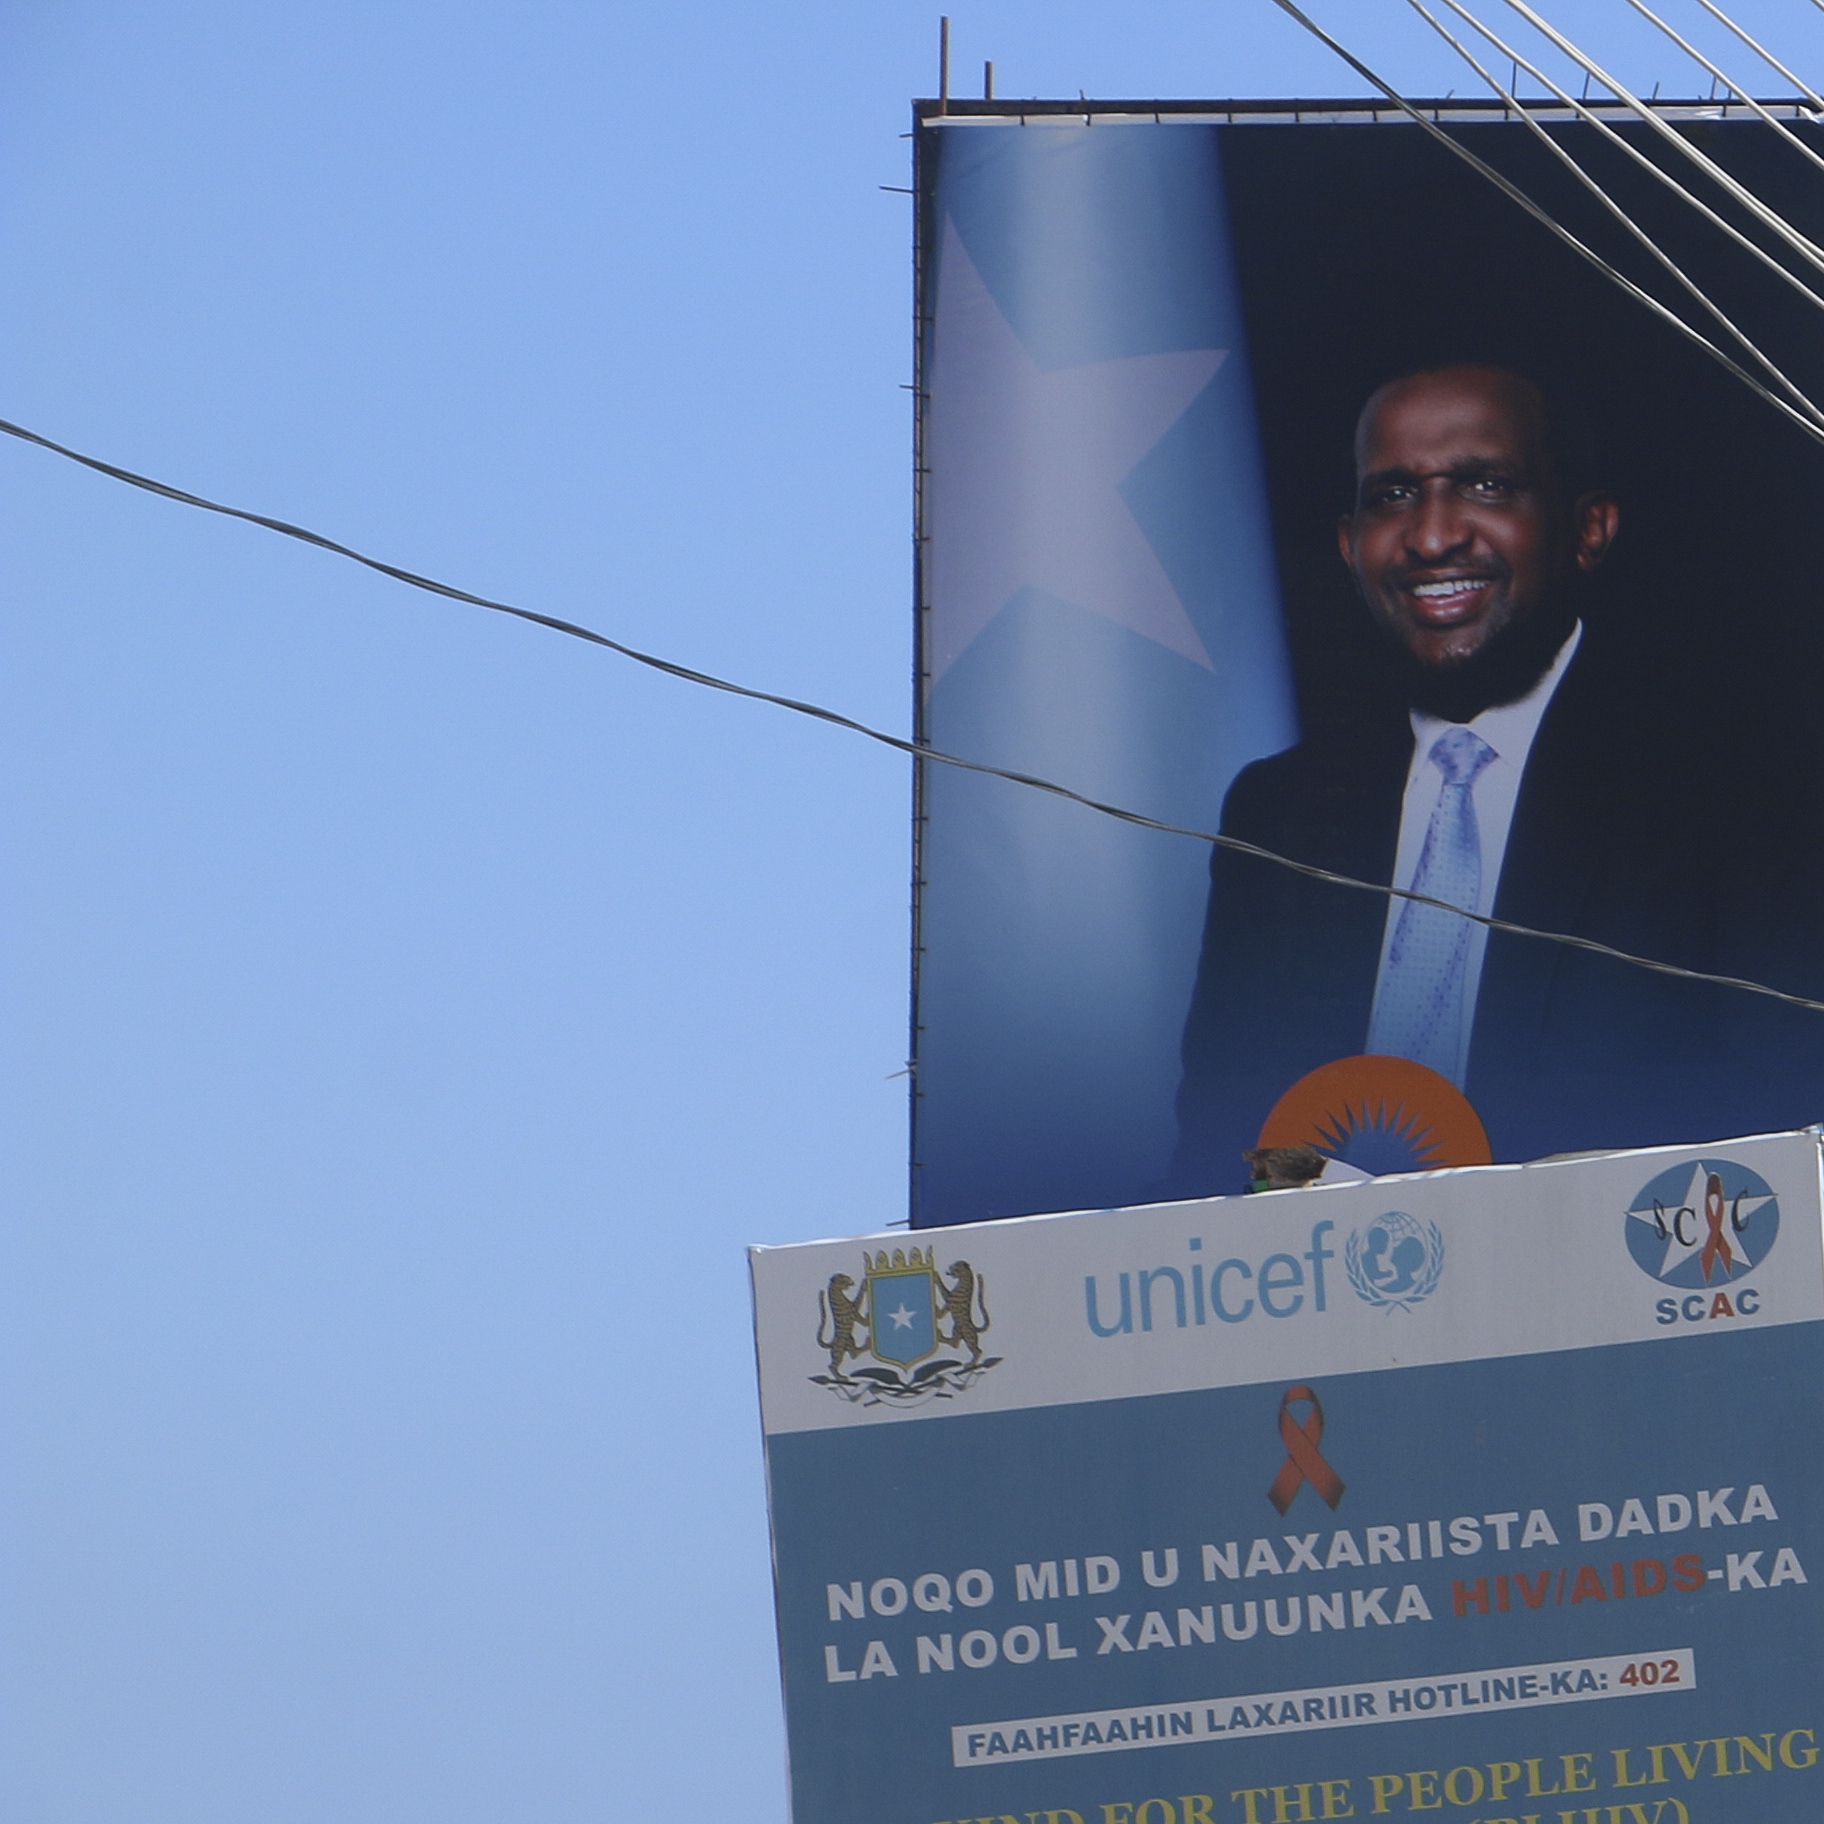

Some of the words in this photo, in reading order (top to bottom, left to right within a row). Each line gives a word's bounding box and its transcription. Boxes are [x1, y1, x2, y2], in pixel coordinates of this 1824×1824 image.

[1085, 1219, 1336, 1338] unicef
[1655, 1287, 1761, 1326] SCAC
[826, 1569, 995, 1621] NOQO
[1015, 1555, 1122, 1602] MID
[1141, 1547, 1180, 1588] U
[1200, 1508, 1560, 1582] NAXARIISTA
[1578, 1484, 1779, 1543] DADKA
[824, 1640, 899, 1684] LA
[916, 1621, 1079, 1674] NOOL
[1095, 1583, 1434, 1656] XANUUNKA
[1450, 1546, 1809, 1618] HIV/AIDS-KA
[967, 1711, 1193, 1758] FAAHFAAHIN
[1206, 1692, 1376, 1733] LAXARIIR
[1388, 1668, 1608, 1714] HOTLINE-KA:
[1619, 1658, 1681, 1688] 402
[1368, 1752, 1598, 1816] PEOPLE
[1610, 1728, 1822, 1789] LIVING
